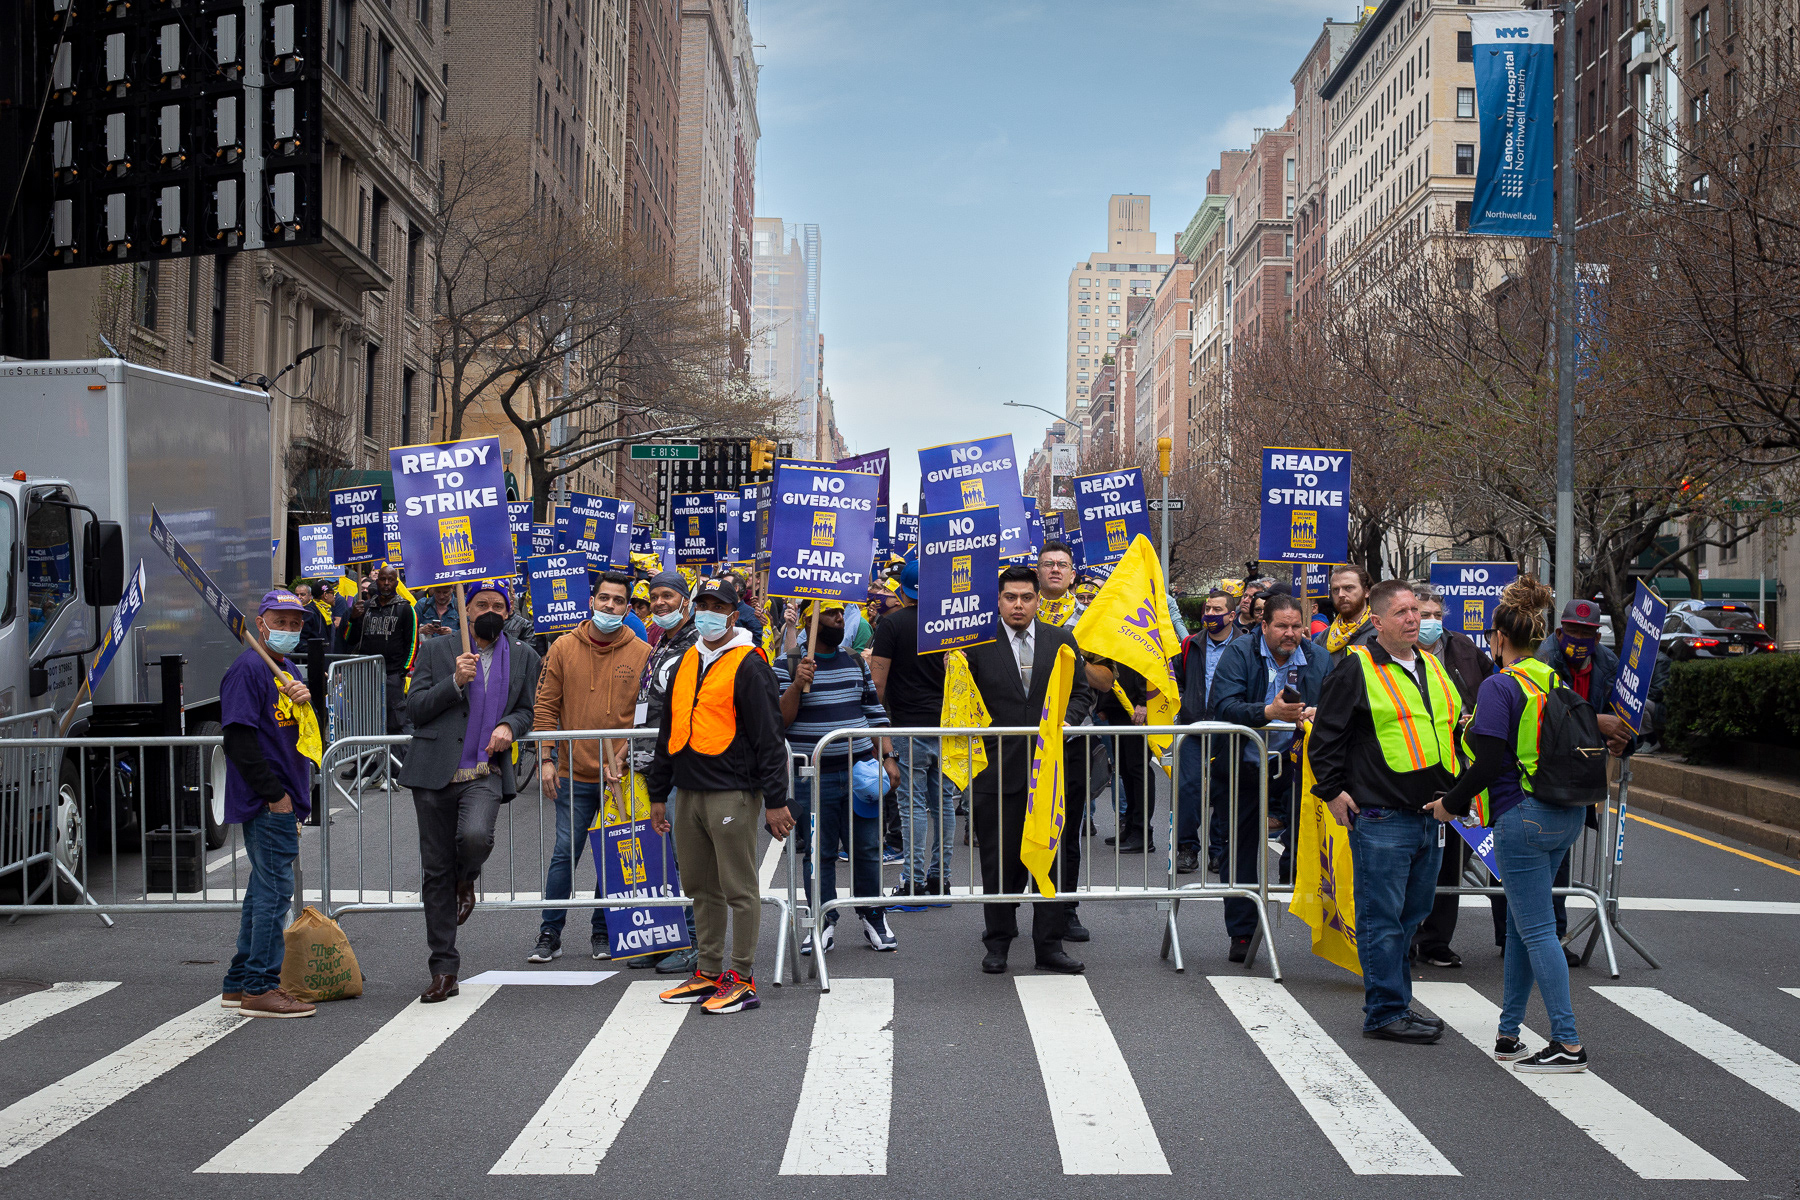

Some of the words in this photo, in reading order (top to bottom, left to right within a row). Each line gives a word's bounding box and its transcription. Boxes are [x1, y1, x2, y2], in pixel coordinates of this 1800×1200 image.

[1495, 27, 1529, 39] NYC
[1504, 51, 1517, 103] Hospital
[1517, 69, 1526, 108] Health
[1506, 106, 1515, 128] Hill
[1515, 111, 1526, 171] Northwell
[1503, 131, 1513, 170] Lenox
[1485, 210, 1537, 221] Northwell.edu
[3, 367, 97, 376] IGSCREENS.COM
[651, 448, 656, 457] E
[660, 448, 668, 457] 81
[671, 448, 679, 457] St
[951, 446, 983, 464] NO
[401, 446, 491, 475] READY
[1271, 454, 1344, 473] READY
[927, 458, 1013, 483] GIVEBACKS
[434, 472, 464, 490] TO
[812, 476, 845, 494] NO
[1081, 473, 1136, 494] READY
[1294, 474, 1318, 488] TO
[335, 490, 378, 505] READY
[762, 486, 771, 498] NO
[1101, 491, 1121, 503] TO
[1268, 488, 1343, 507] STRIKE
[350, 504, 365, 514] TO
[405, 487, 499, 517] STRIKE
[587, 498, 603, 509] NO
[686, 497, 700, 507] NO
[783, 493, 872, 511] GIVEBACKS
[572, 506, 616, 520] GIVEBACKS
[675, 507, 714, 515] GIVEBACKS
[1084, 500, 1142, 521] STRIKE
[336, 512, 380, 528] STRIKE
[900, 517, 918, 525] REA
[949, 517, 975, 537] NO
[302, 534, 334, 542] GIVEBAC
[314, 527, 328, 535] NO
[576, 540, 600, 553] FAIR
[685, 538, 706, 548] FAIR
[926, 534, 997, 556] GIVEBACKS
[445, 552, 472, 560] BUILDING
[678, 548, 715, 556] CONTRACT
[797, 549, 846, 569] FAIR
[312, 557, 333, 565] FAIR
[447, 557, 471, 565] STRONG
[548, 557, 568, 569] NO
[435, 570, 455, 580] 32BJ
[468, 567, 487, 576] SEIU
[532, 567, 585, 580] GIVEBACKS
[777, 567, 863, 585] CONTRACT
[1295, 575, 1327, 586] COTRACT
[1461, 569, 1489, 583] NO
[794, 586, 812, 594] 32BJ
[1435, 585, 1506, 596] GIVEBACK
[548, 601, 576, 613] FAIR
[941, 595, 980, 616] FAIR
[1642, 595, 1653, 616] NO
[538, 611, 589, 623] CONTRACT
[925, 612, 994, 634] CONTRACT
[1631, 606, 1661, 641] GIVEBACKS
[941, 638, 956, 646] 32BJ
[964, 633, 979, 641] SEIU
[1118, 625, 1162, 660] Stronger
[1622, 665, 1640, 693] FAIR
[1616, 678, 1643, 714] CONTRACT
[1617, 805, 1627, 861] NYPD
[632, 910, 655, 927] TO
[616, 924, 682, 952] READY
[308, 959, 332, 973] You
[304, 968, 352, 991] Shopping
